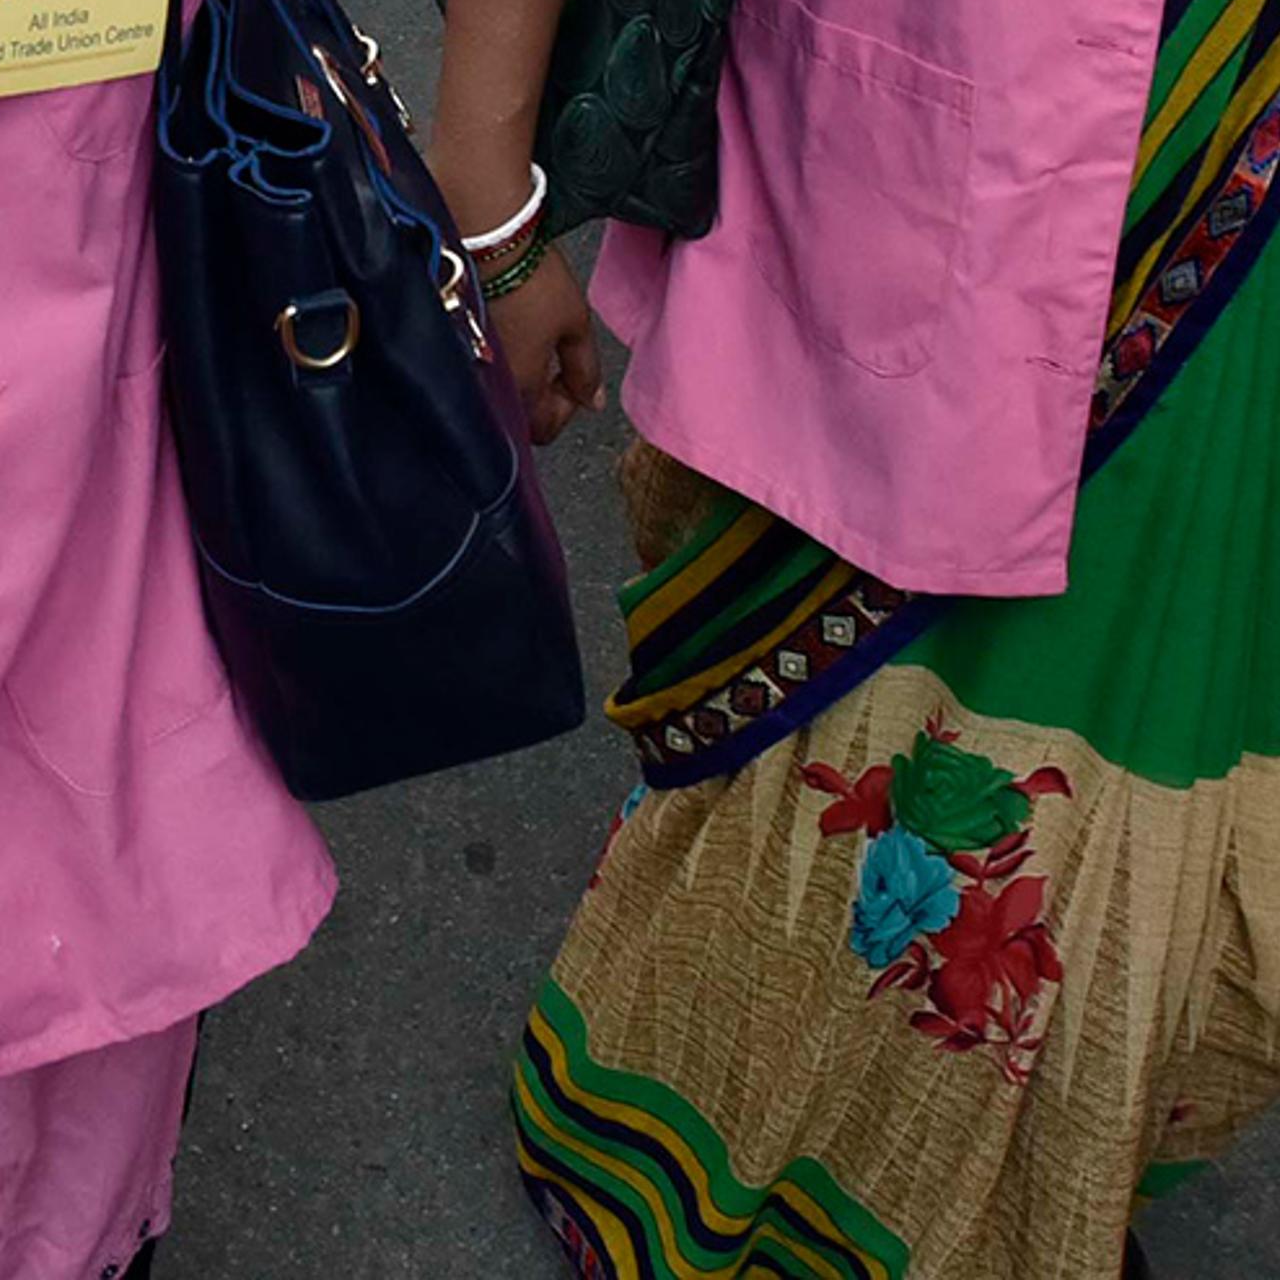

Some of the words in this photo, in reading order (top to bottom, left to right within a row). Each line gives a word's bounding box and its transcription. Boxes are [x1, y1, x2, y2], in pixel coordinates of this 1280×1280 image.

[28, 12, 50, 32] All
[52, 7, 90, 28] India
[10, 39, 55, 59] Trade
[57, 31, 102, 53] Union
[104, 21, 155, 46] Centre
